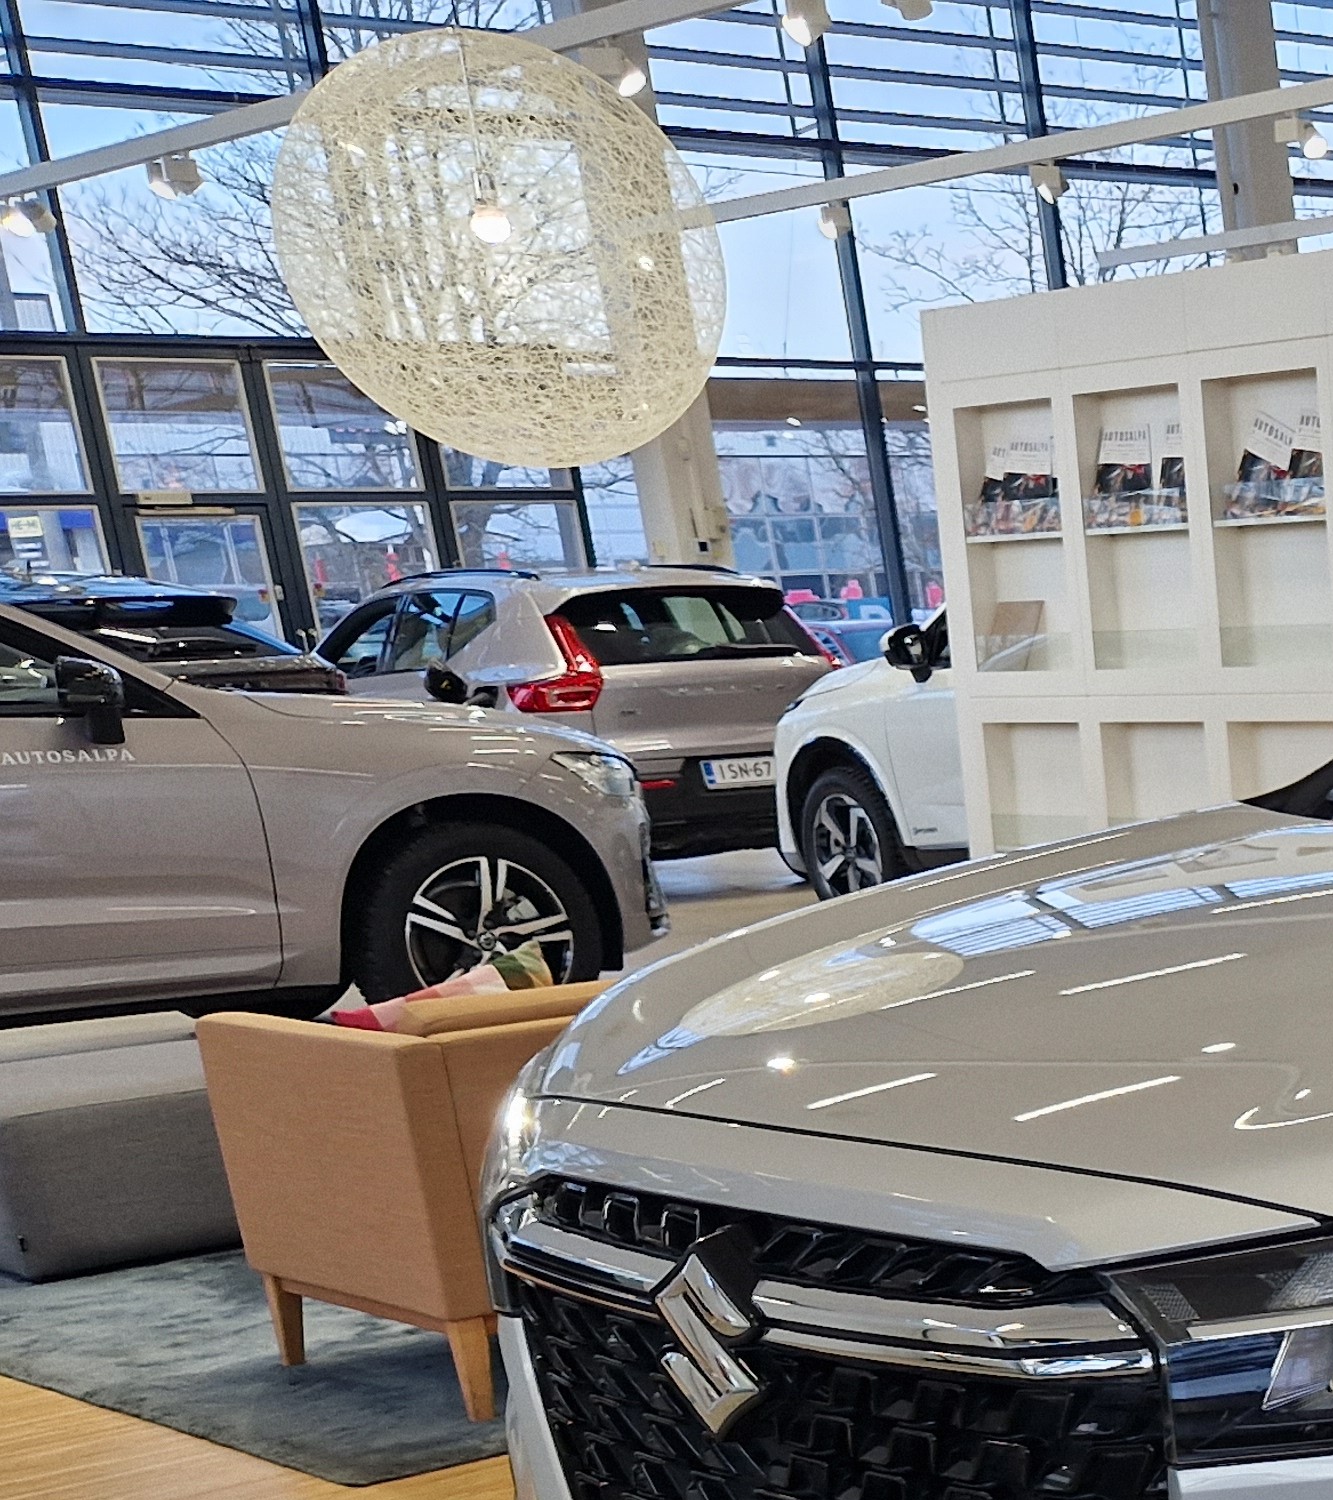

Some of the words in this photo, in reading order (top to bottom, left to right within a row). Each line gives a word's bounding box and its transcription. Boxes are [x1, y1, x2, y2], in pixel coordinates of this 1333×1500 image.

[1254, 418, 1293, 445] AUTOSALP
[1, 749, 136, 765] AUTOSALPA
[719, 761, 772, 780] ISN-67
